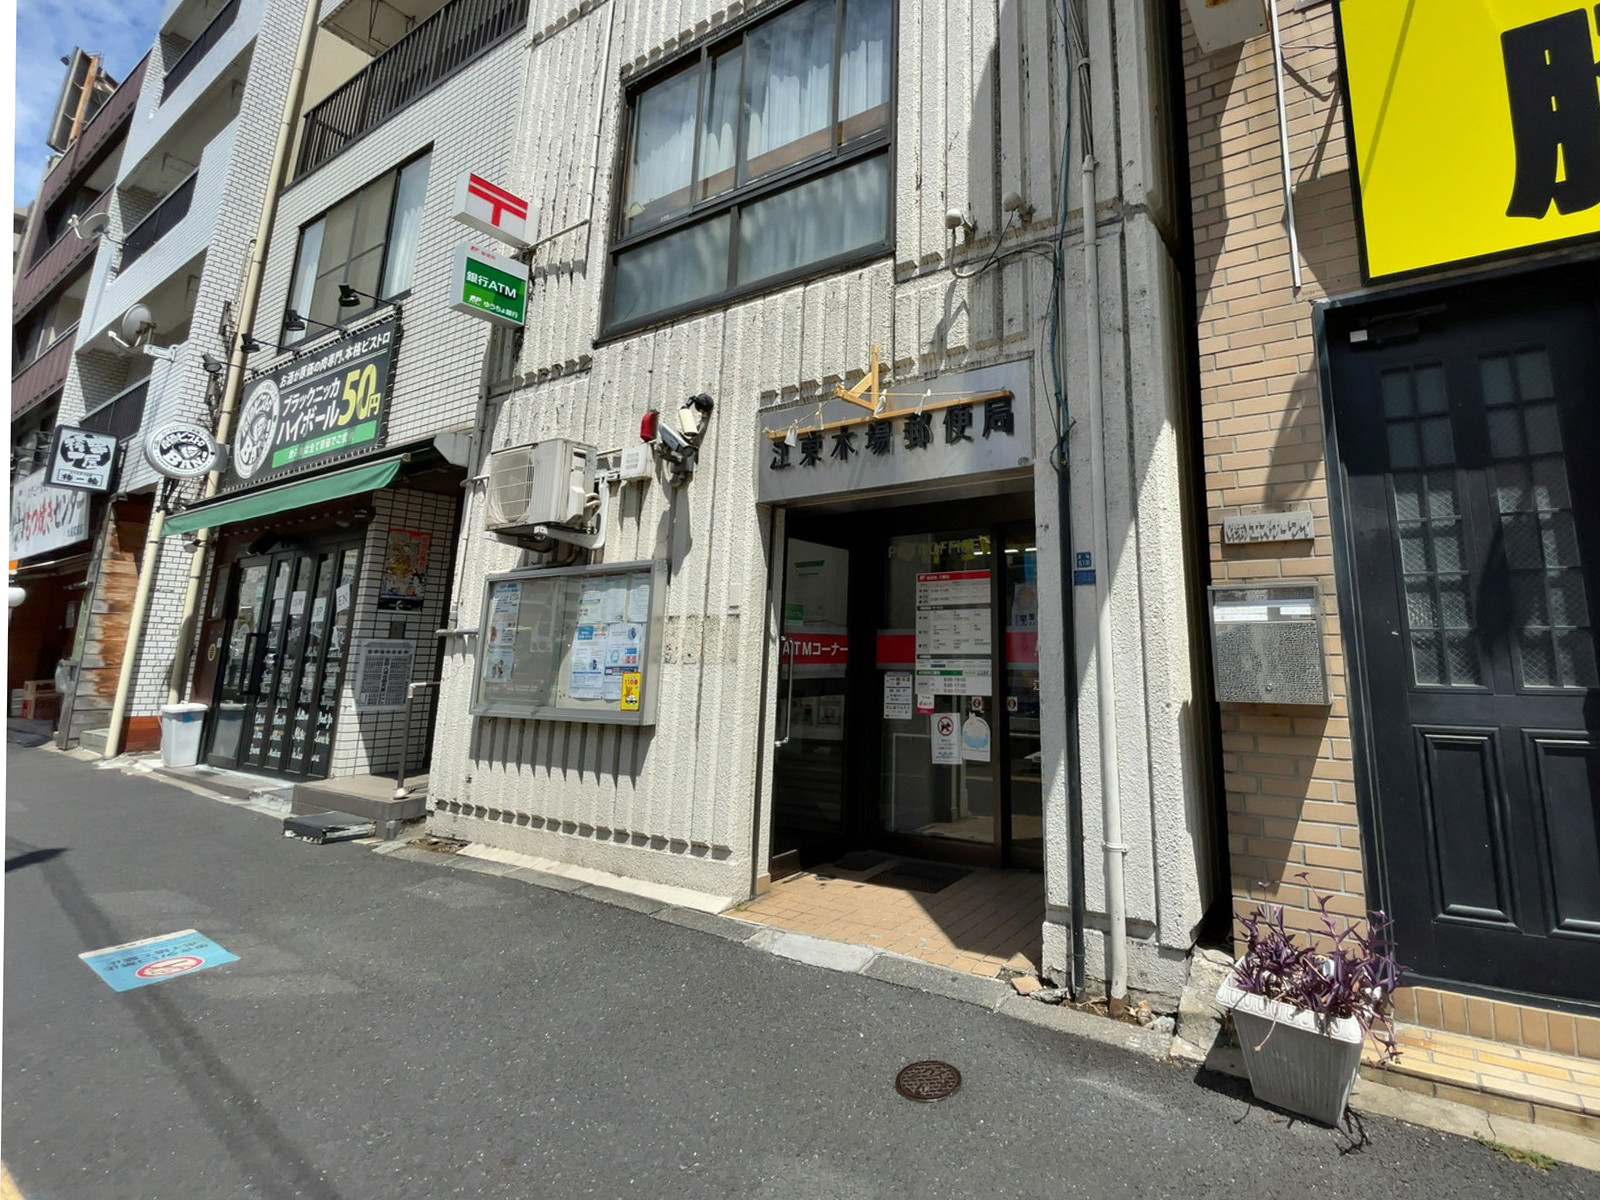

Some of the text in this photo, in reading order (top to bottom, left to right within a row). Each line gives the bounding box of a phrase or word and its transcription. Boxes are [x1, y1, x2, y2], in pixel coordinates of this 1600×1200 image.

[466, 270, 517, 299] 銀行ATM
[483, 301, 518, 319] ゆうちょ銀行
[282, 377, 341, 416] ブラックニッカ
[276, 401, 341, 445] ハイボール
[769, 398, 1016, 471] 江東木場郵便局
[782, 641, 848, 656] ATMコーナー
